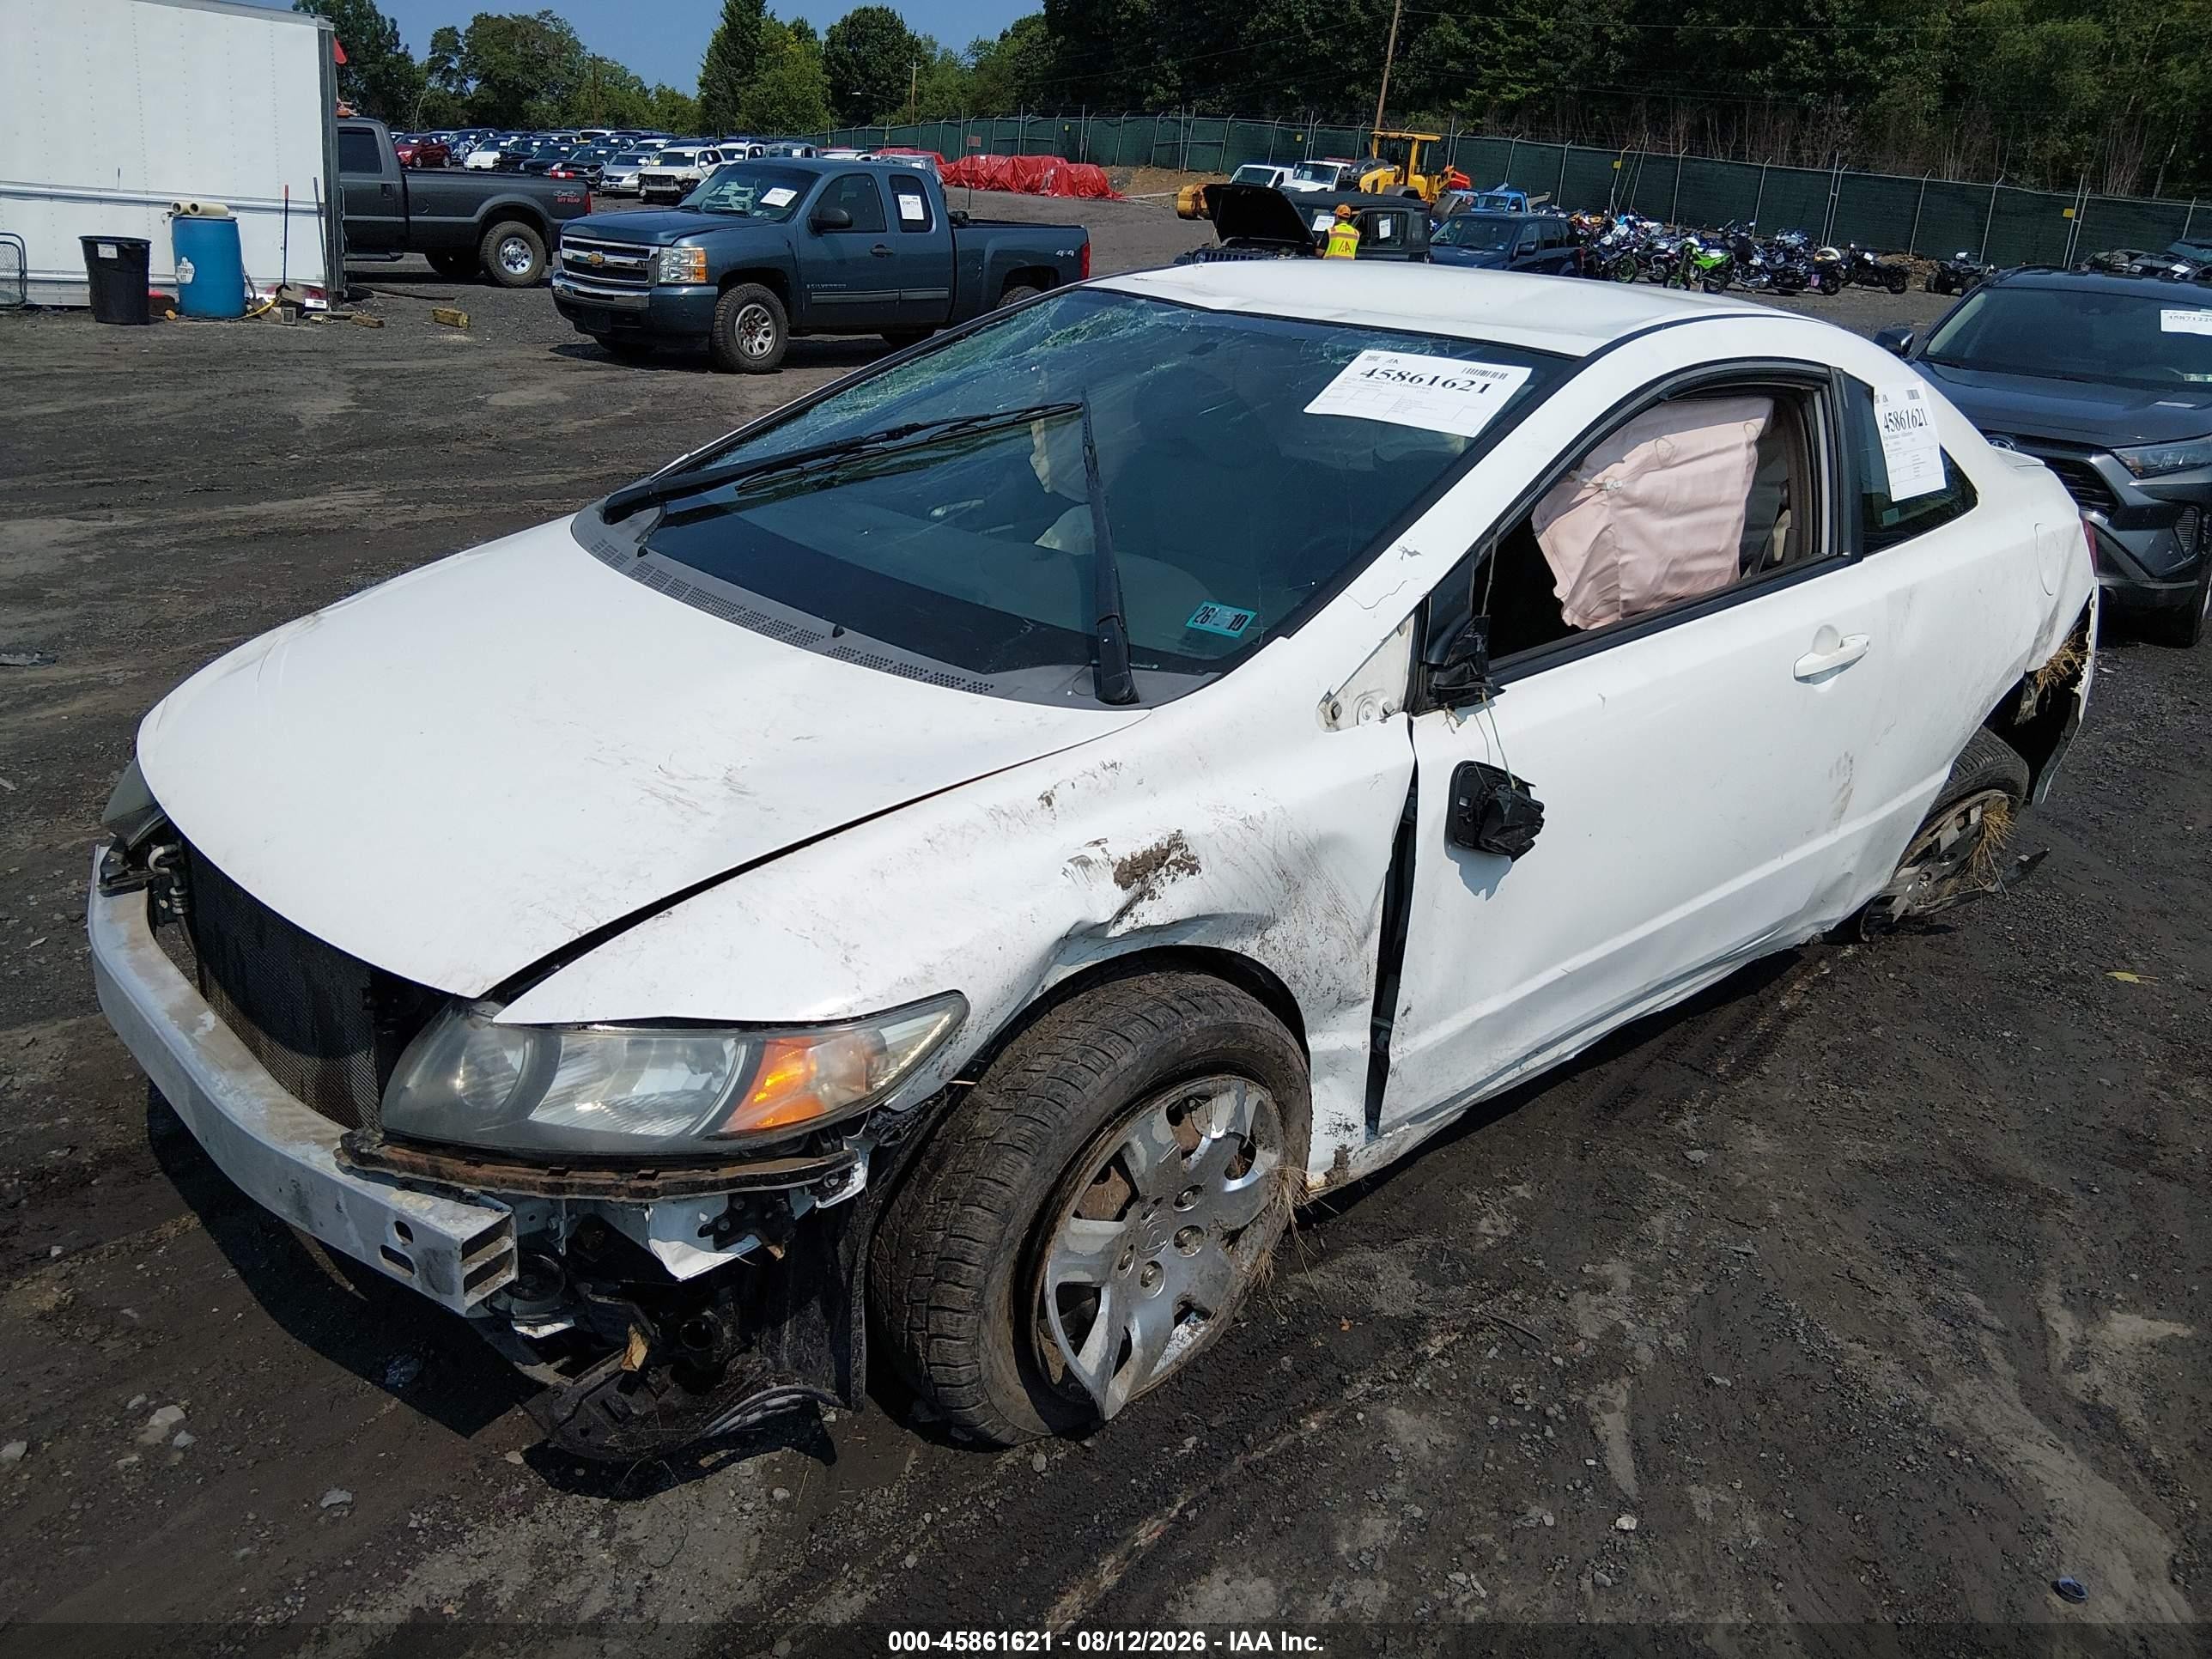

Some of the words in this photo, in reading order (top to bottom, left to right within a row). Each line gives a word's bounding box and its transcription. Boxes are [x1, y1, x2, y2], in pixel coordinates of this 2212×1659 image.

[1359, 367, 1492, 395] 45861621
[1882, 407, 1929, 433] 45861621
[1193, 605, 1217, 624] 26
